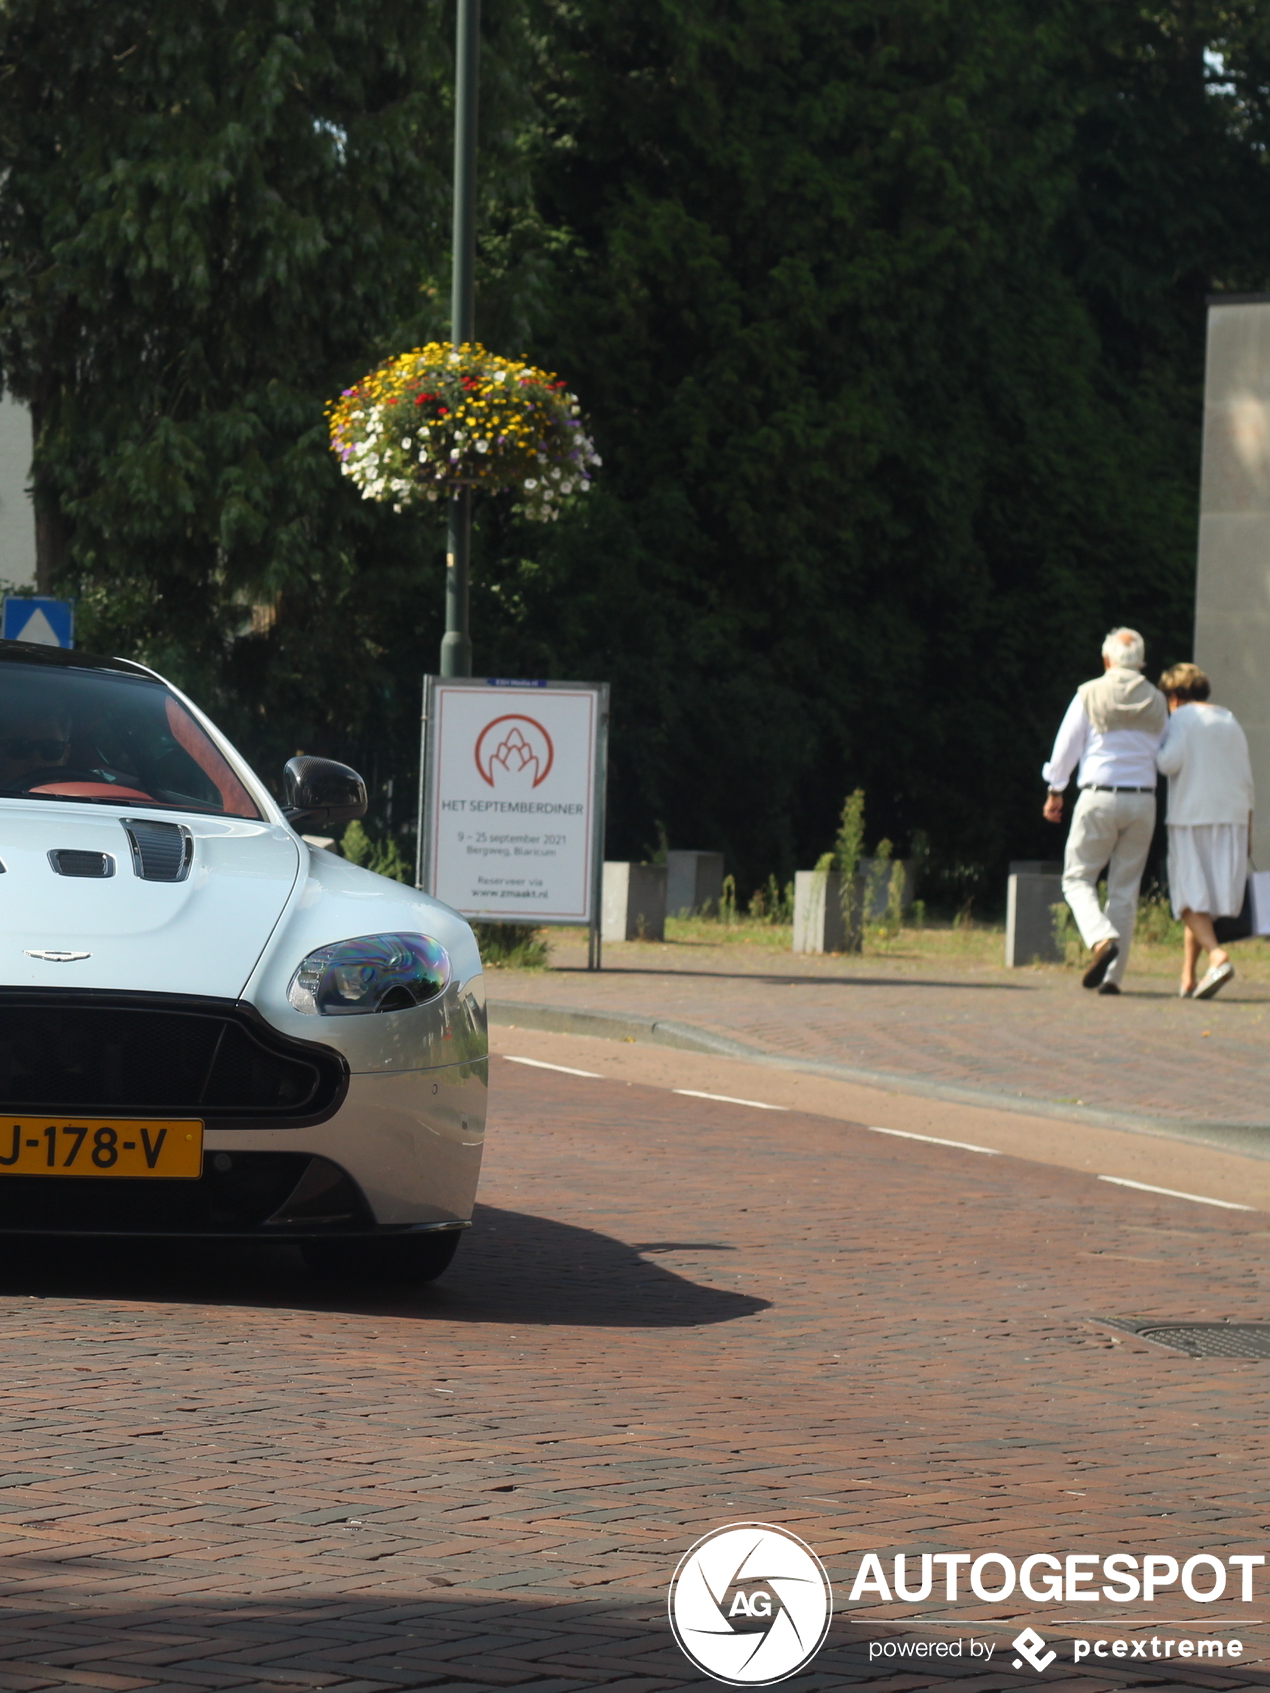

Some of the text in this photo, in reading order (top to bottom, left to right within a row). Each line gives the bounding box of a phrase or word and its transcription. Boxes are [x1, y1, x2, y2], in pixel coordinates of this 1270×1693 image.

[442, 800, 584, 815] HET SEPTEMBERDINER
[457, 832, 464, 842] 9
[475, 832, 487, 843] 25
[490, 833, 541, 845] september
[544, 834, 567, 845] 2021
[514, 846, 557, 857] Blaricum
